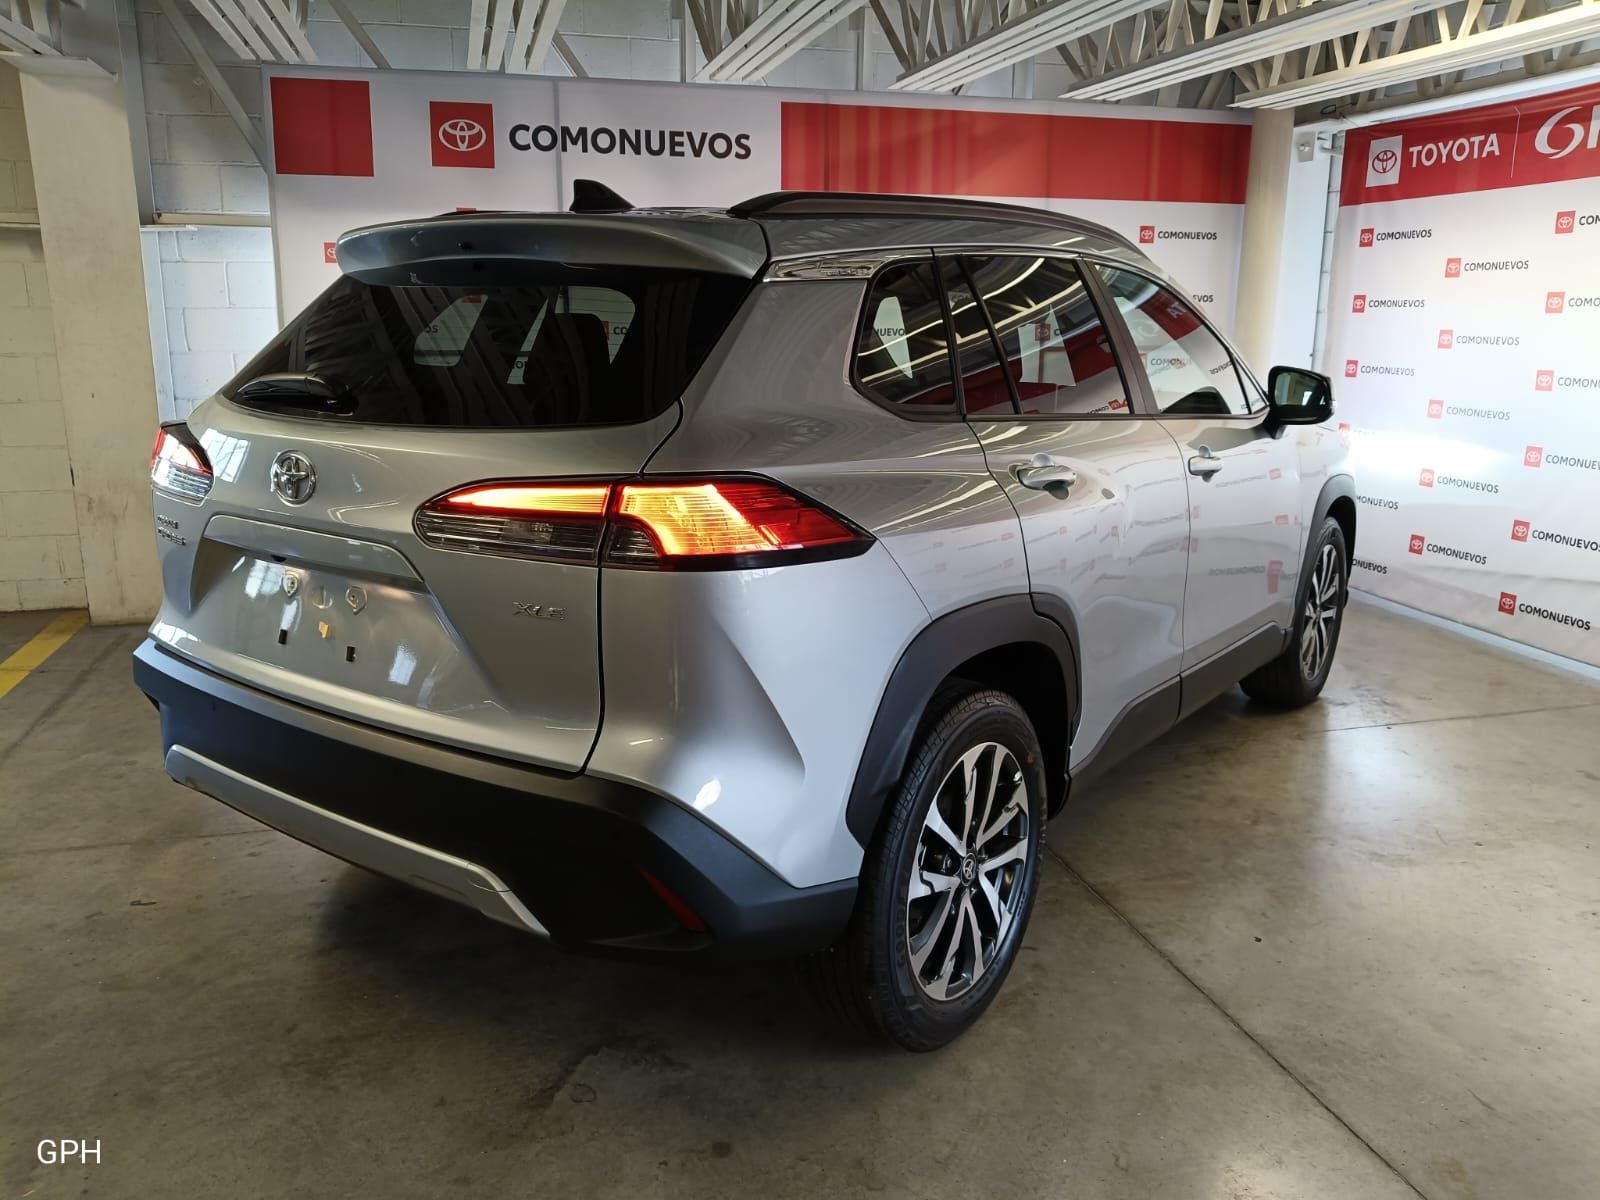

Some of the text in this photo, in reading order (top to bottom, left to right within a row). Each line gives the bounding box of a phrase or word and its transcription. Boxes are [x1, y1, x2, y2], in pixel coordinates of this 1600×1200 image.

[508, 124, 752, 160] COMONUEVOS
[1409, 133, 1501, 168] TOYOTA
[1157, 230, 1218, 241] COMONUEVOS
[1376, 229, 1432, 242] COMONUEVOS
[1464, 260, 1529, 272] COMONUEVOS
[1368, 299, 1425, 308] COMONUEVOS
[1456, 335, 1520, 346] COMONUEVOS
[1360, 365, 1415, 377] COMONUEVOS
[1557, 376, 1600, 389] COMON
[1446, 406, 1511, 421] COMONUEVOS
[1437, 475, 1499, 494] COMONUEVOS
[1531, 529, 1600, 552] COMONUEVO
[1426, 543, 1488, 565] COMONUEVOS
[1518, 603, 1591, 631] COMONUEVOS
